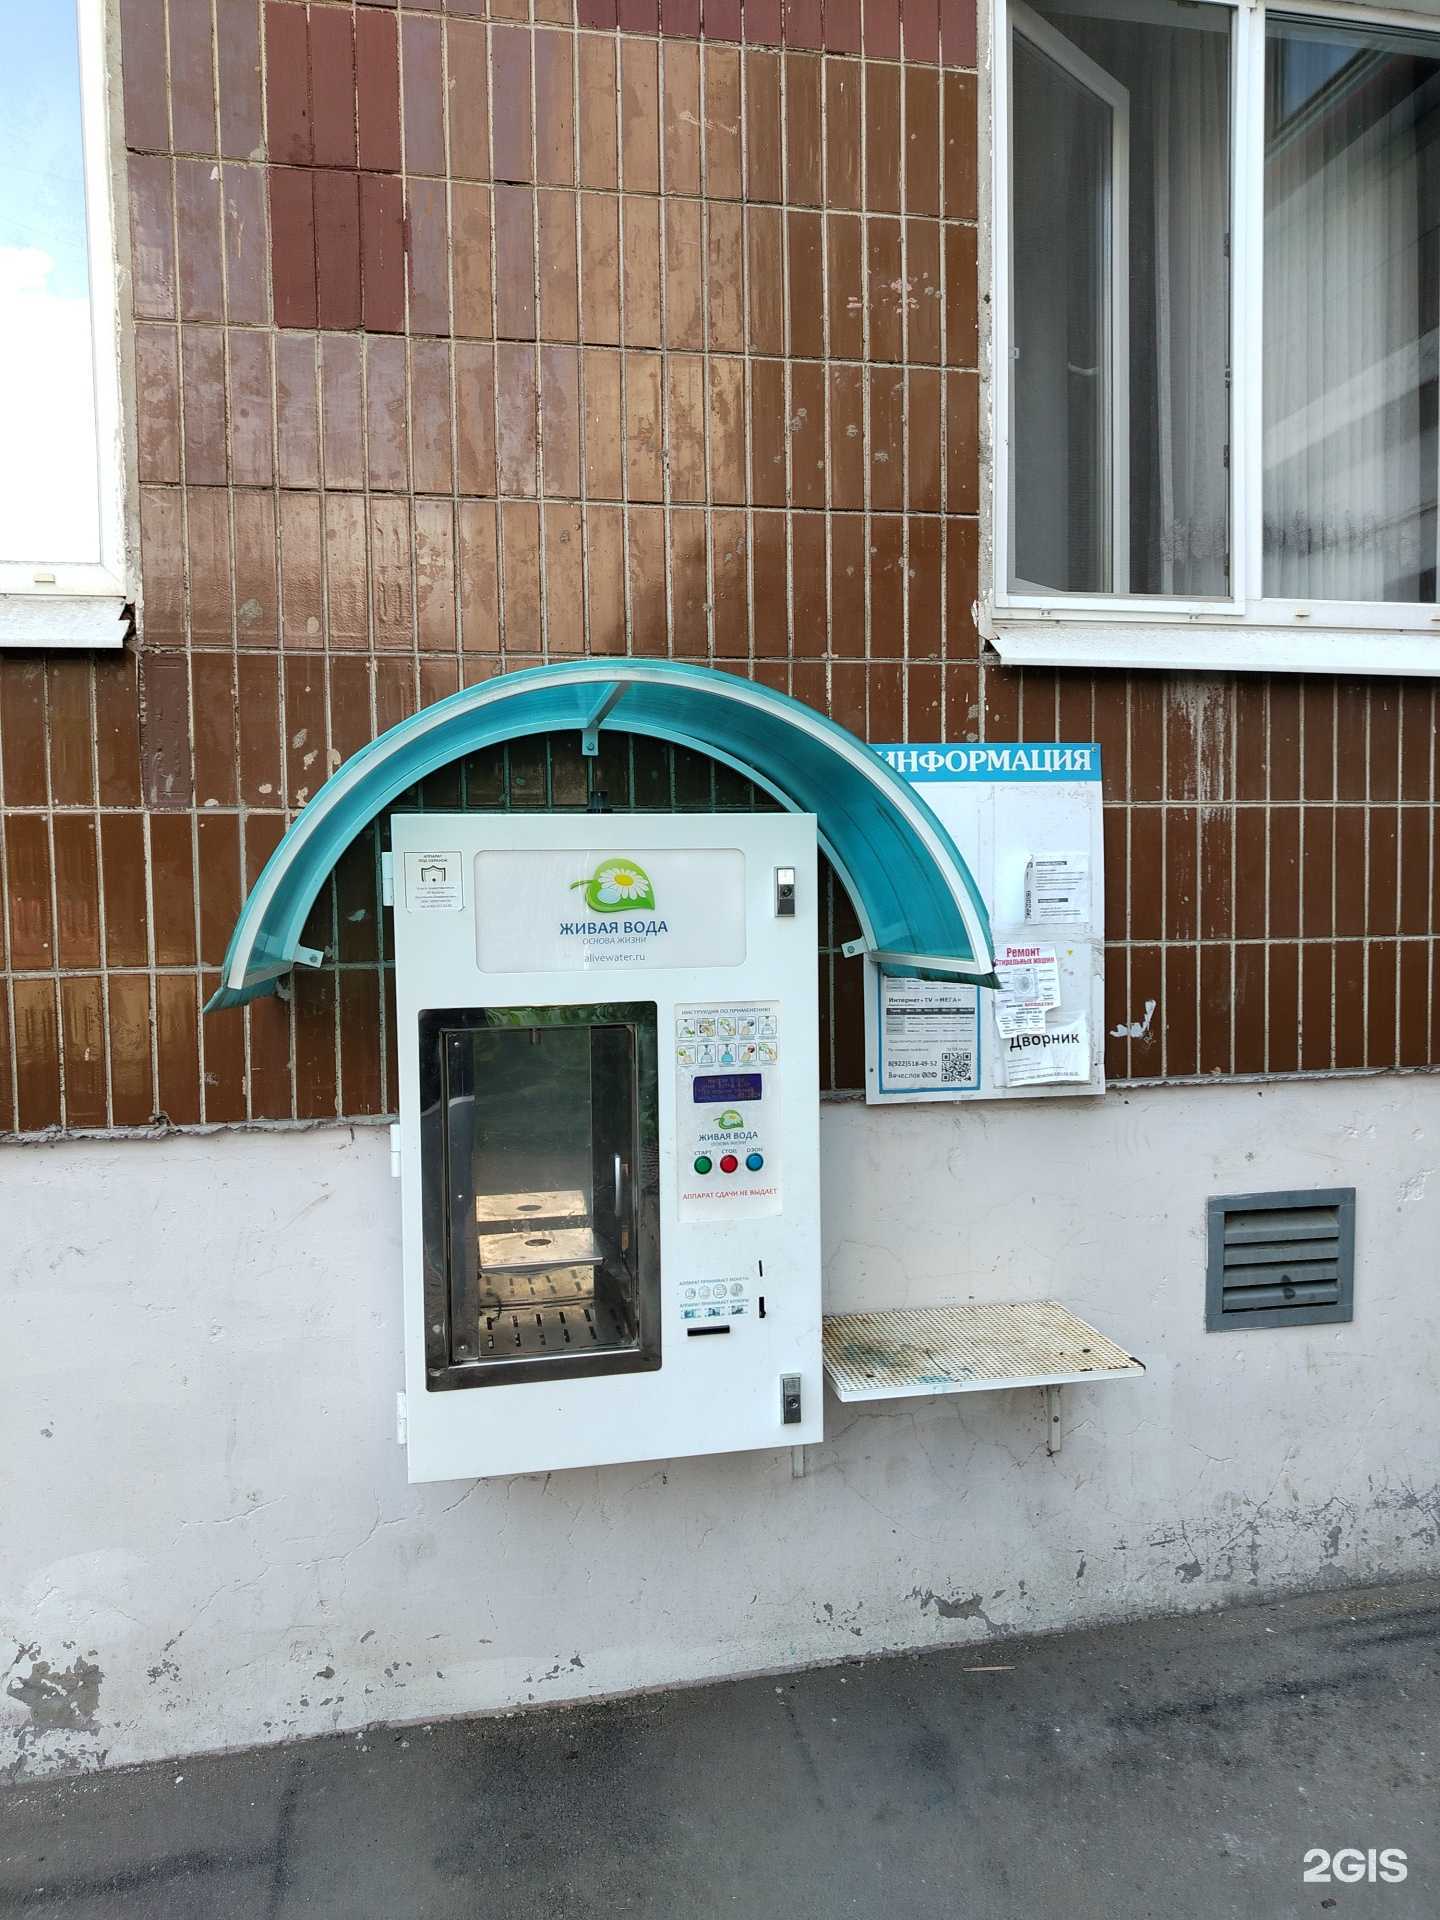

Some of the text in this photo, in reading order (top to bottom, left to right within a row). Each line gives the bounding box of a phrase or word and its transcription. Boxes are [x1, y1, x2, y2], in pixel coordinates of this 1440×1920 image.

[560, 920, 668, 936] ЖИВАЯ ВОДА
[582, 936, 647, 945] ОСНОВА ЖИЗНИ
[584, 953, 646, 963] alivewater.ru
[1006, 947, 1041, 958] Ремонт
[1010, 1033, 1080, 1052] Дворник
[699, 1131, 758, 1141] ЖИВАЯ ВОДА
[682, 1192, 713, 1200] АППАРАТ
[715, 1191, 738, 1199] СДАЧИ
[749, 1188, 777, 1197] ВЫДАЕТ
